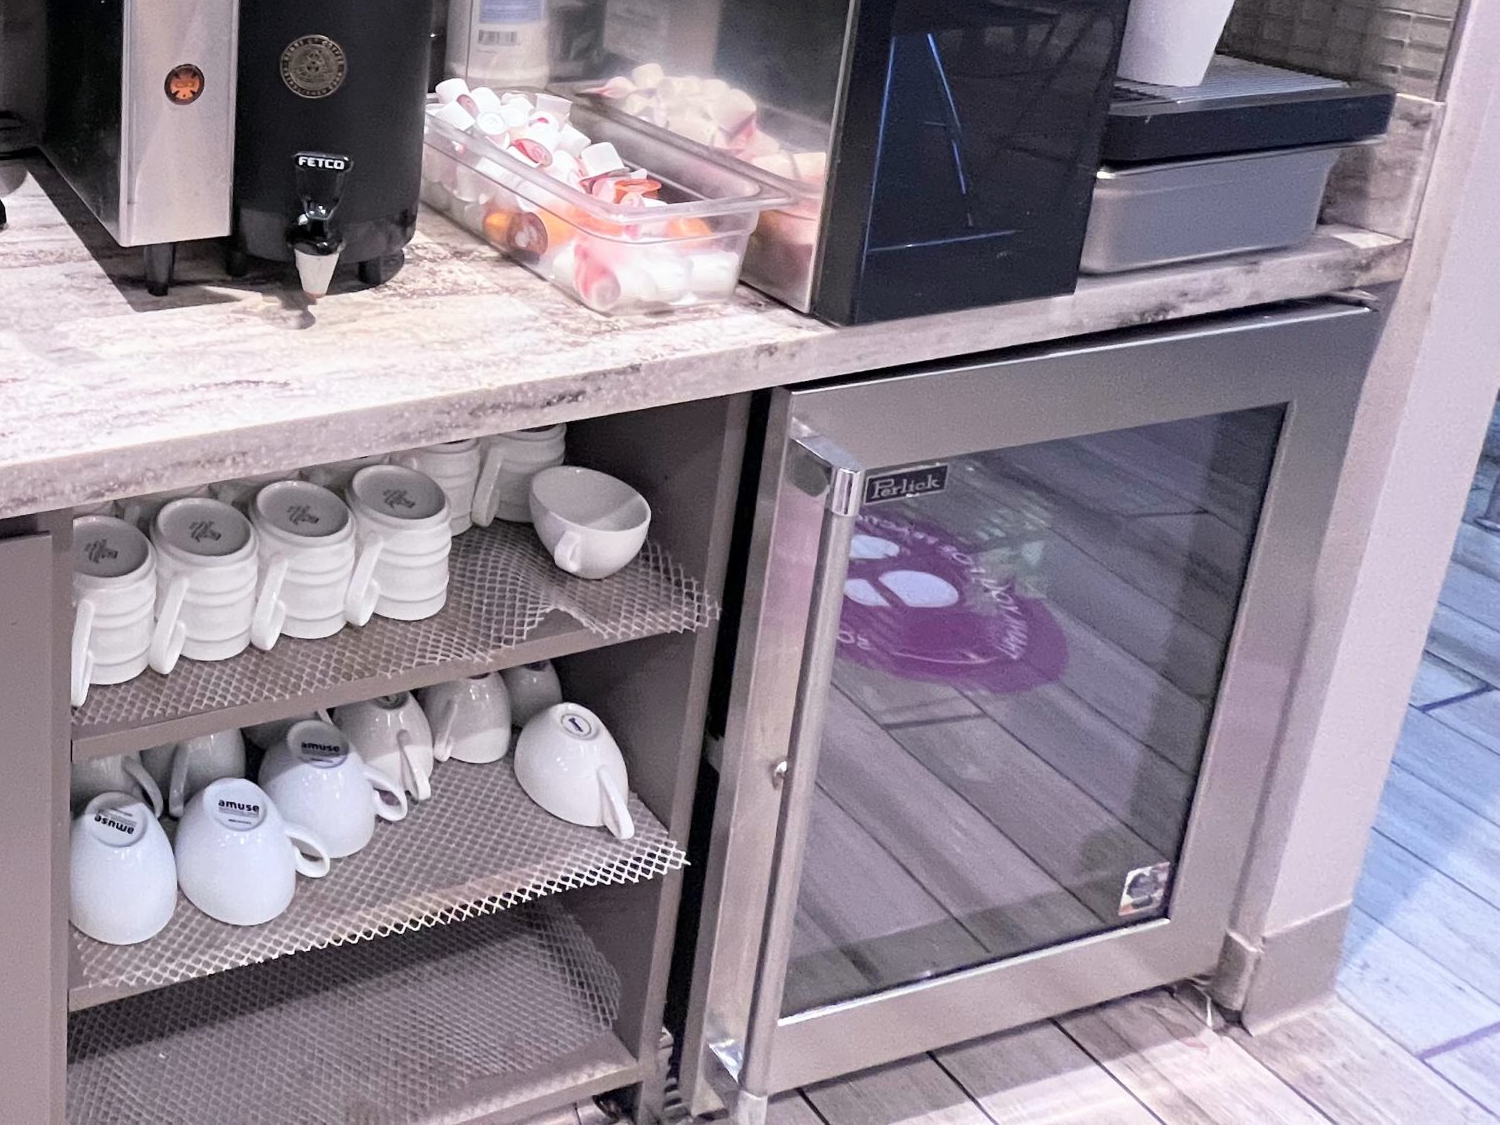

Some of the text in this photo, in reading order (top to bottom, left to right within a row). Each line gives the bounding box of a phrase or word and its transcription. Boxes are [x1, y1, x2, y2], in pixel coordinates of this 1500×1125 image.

[299, 156, 345, 170] FETCO
[870, 474, 941, 500] Perlick
[301, 741, 341, 753] amuse
[218, 798, 260, 813] amuse
[93, 813, 135, 835] amuse
